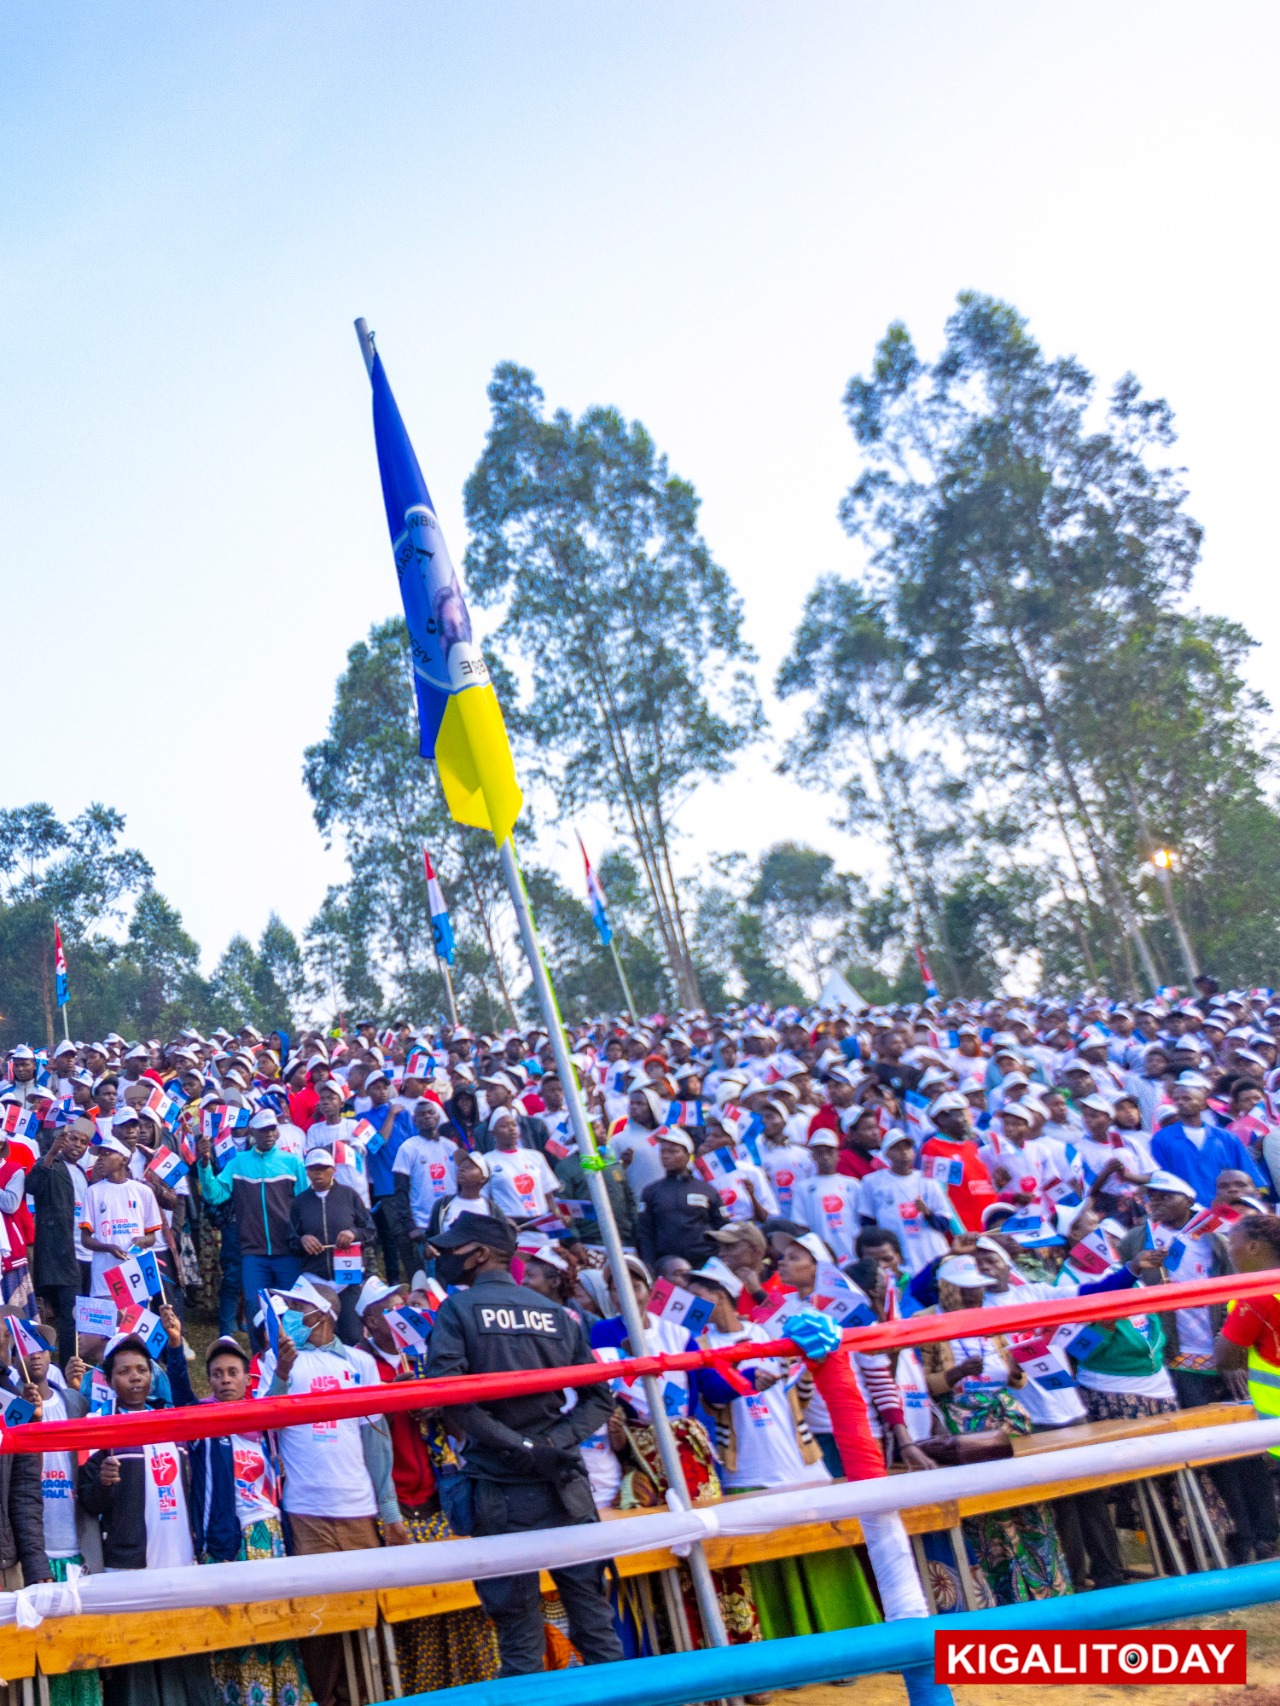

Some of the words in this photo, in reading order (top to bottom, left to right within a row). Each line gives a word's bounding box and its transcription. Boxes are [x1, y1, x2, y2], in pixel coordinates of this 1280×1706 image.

[112, 1266, 156, 1297] FPR
[652, 1289, 705, 1322] FPR
[833, 1301, 863, 1326] PR
[121, 1314, 164, 1347] FPR
[396, 1315, 424, 1335] PR
[481, 1308, 557, 1333] POLICE
[1059, 1328, 1090, 1349] PR
